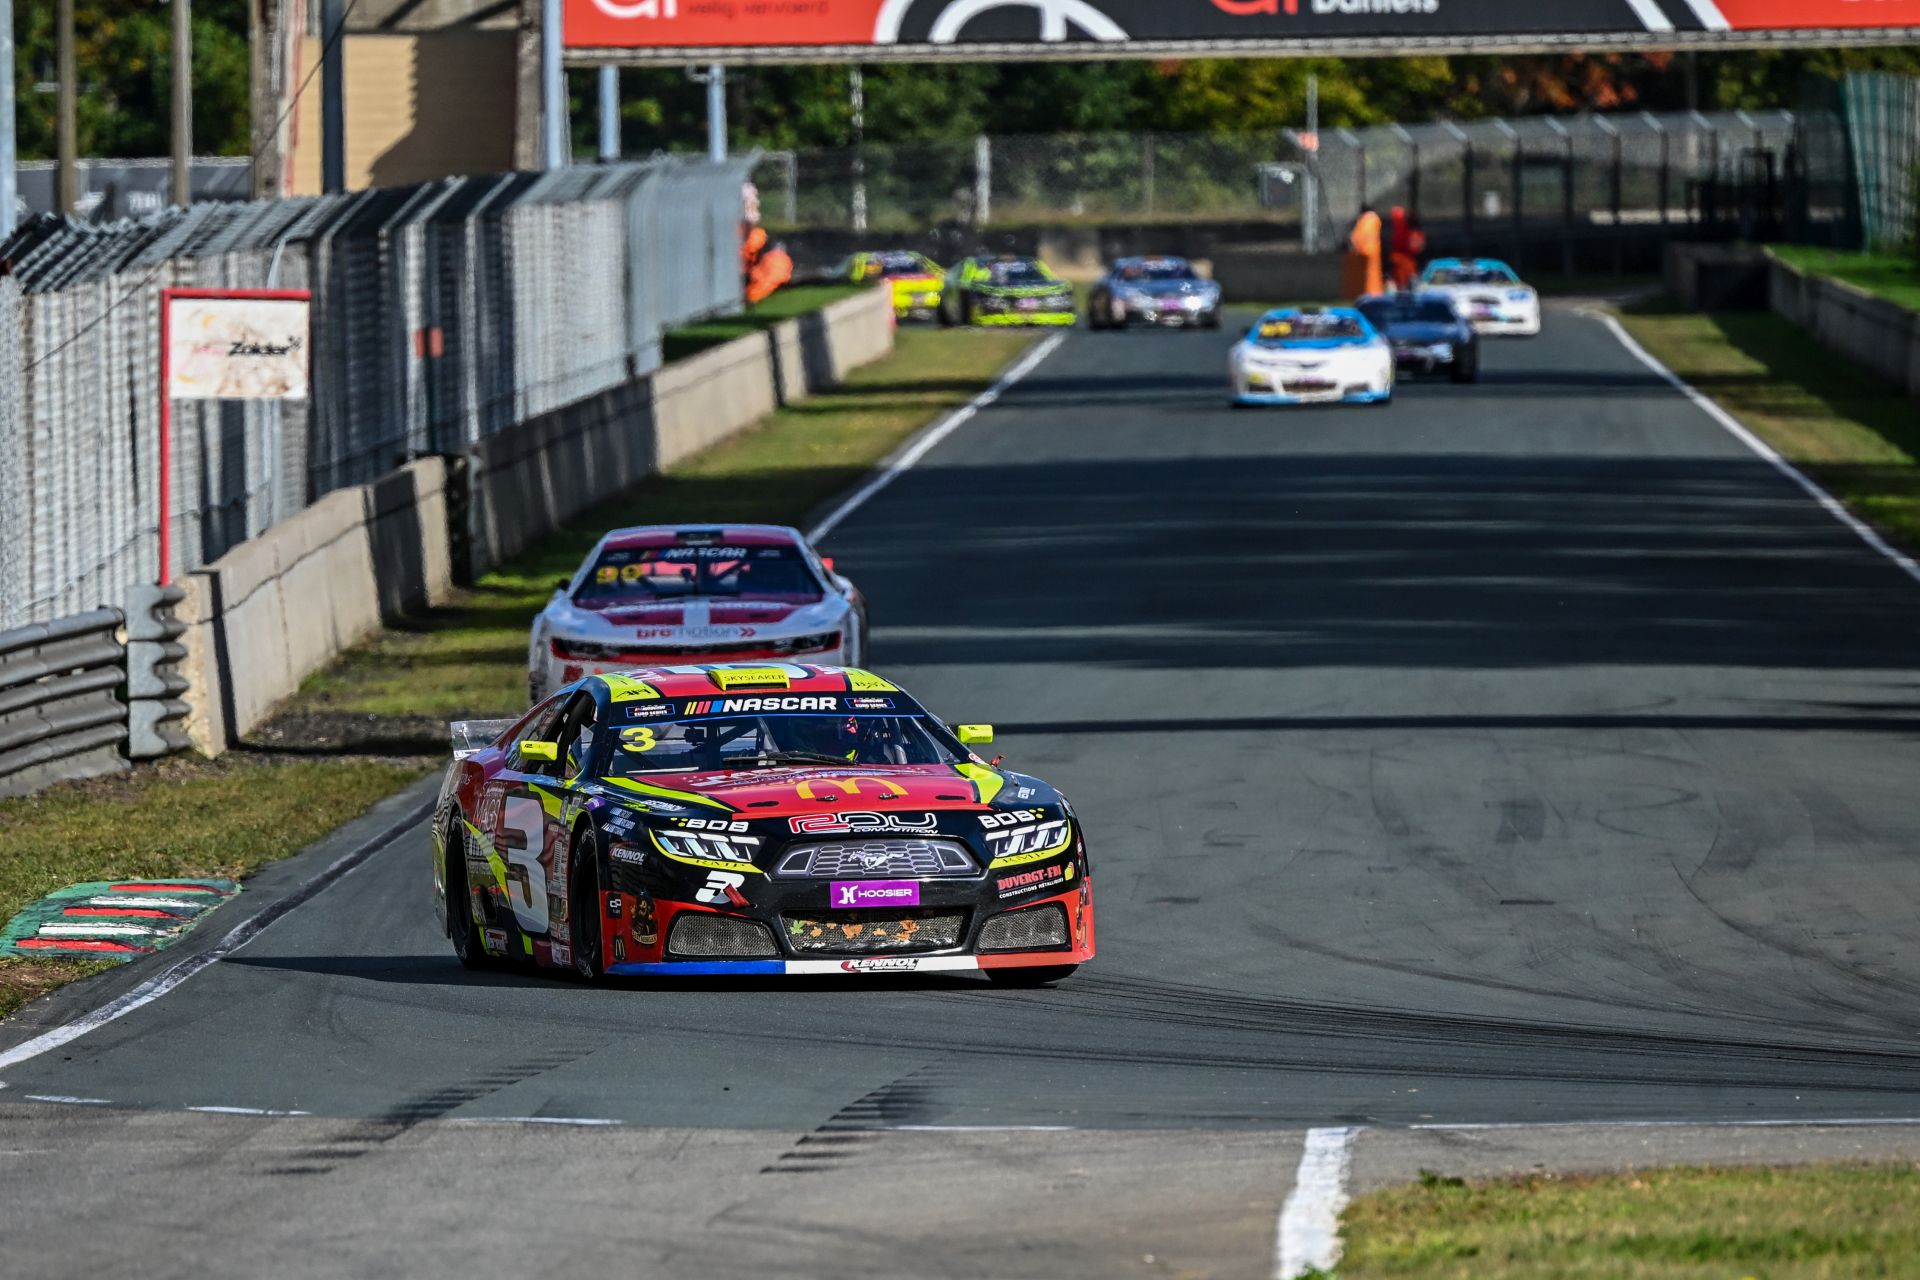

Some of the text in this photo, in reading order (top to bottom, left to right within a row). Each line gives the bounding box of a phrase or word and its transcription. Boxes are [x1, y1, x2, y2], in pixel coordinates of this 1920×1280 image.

[722, 697, 837, 713] NASCAR
[622, 727, 656, 752] 3
[853, 826, 939, 835] COMPETITION
[611, 847, 646, 862] KENNOL
[503, 795, 550, 934] 3
[858, 888, 913, 898] HOOSIER
[847, 958, 918, 968] KENNOL
